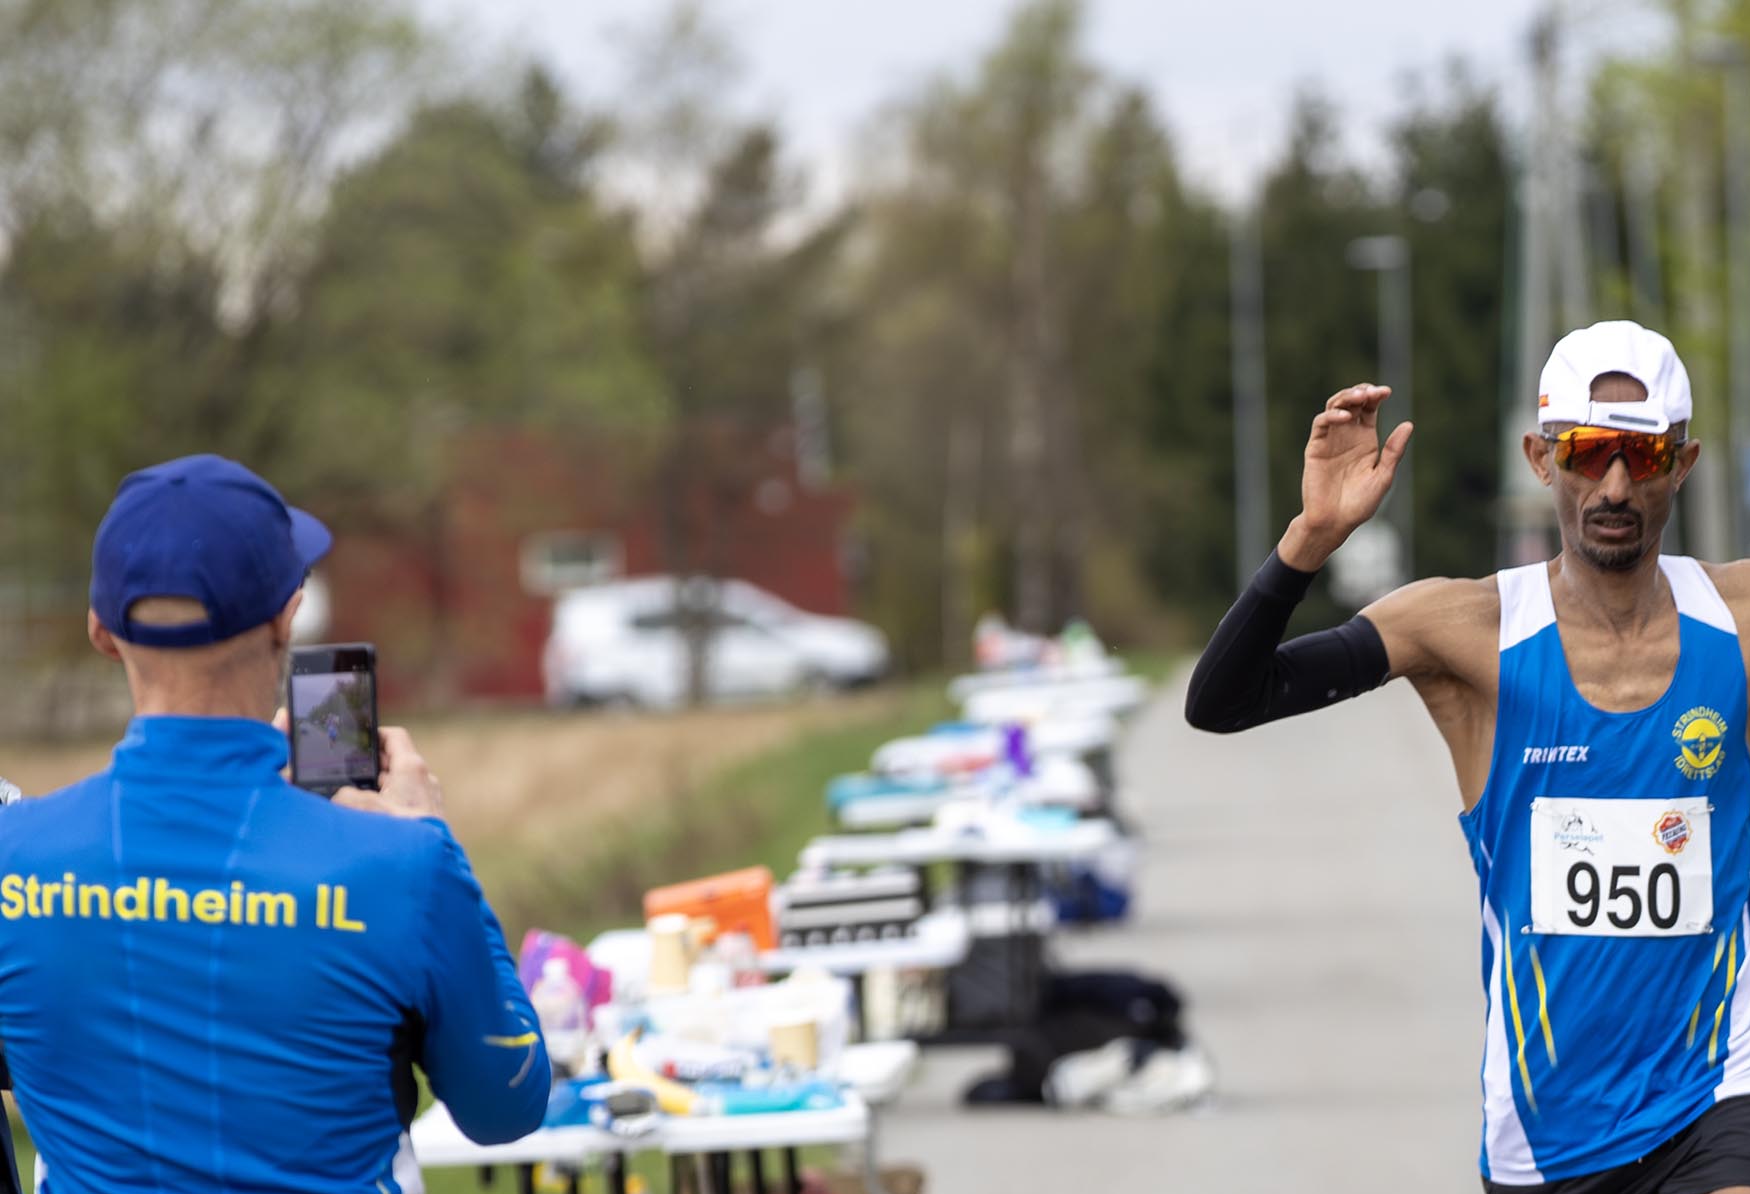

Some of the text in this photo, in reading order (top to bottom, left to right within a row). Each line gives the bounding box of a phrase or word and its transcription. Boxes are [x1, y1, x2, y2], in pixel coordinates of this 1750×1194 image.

[1, 872, 366, 932] Strindheim IL
[1566, 861, 1681, 929] 950
